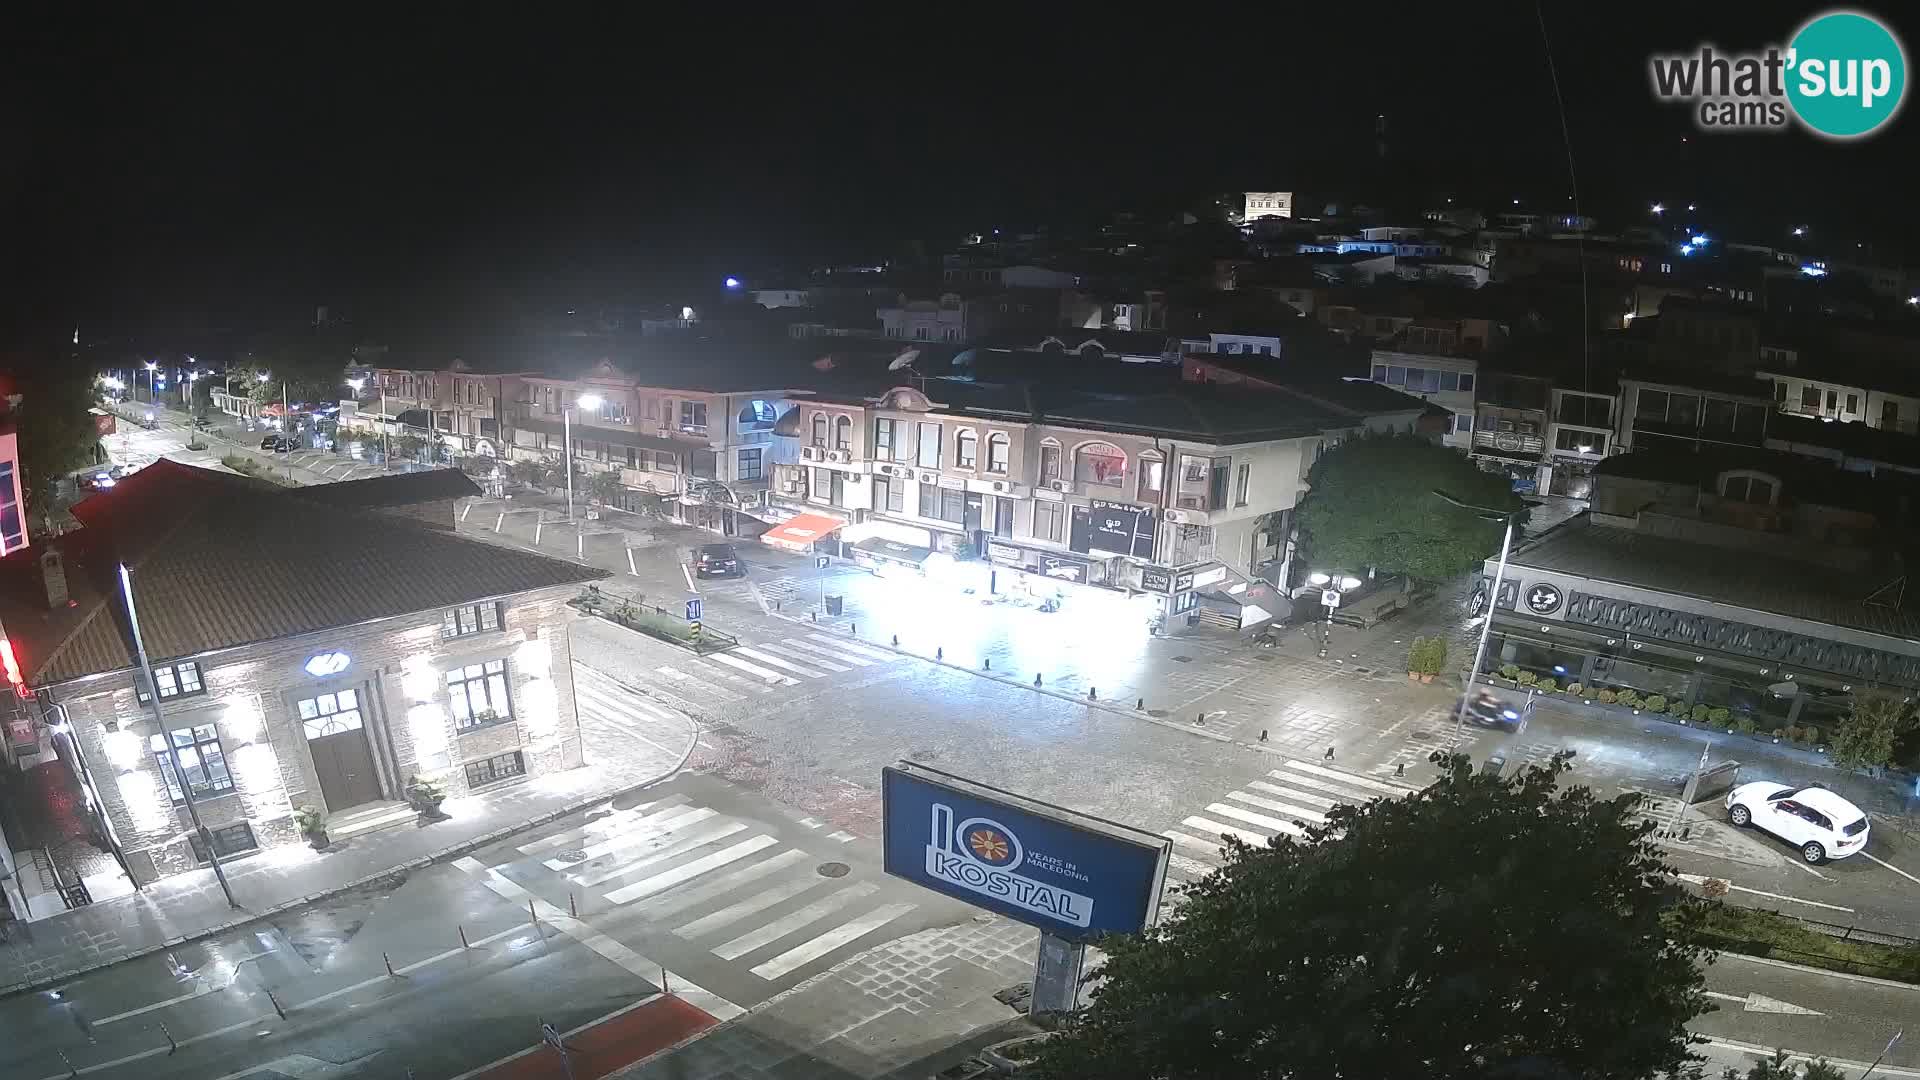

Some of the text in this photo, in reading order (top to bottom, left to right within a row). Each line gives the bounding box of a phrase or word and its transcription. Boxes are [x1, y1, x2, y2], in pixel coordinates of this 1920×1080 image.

[819, 558, 827, 569] P
[931, 803, 1023, 872] 10
[1026, 857, 1089, 883] MACEDONIA
[1028, 850, 1077, 871] YEARS IN
[936, 853, 1081, 920] KOSTAL
